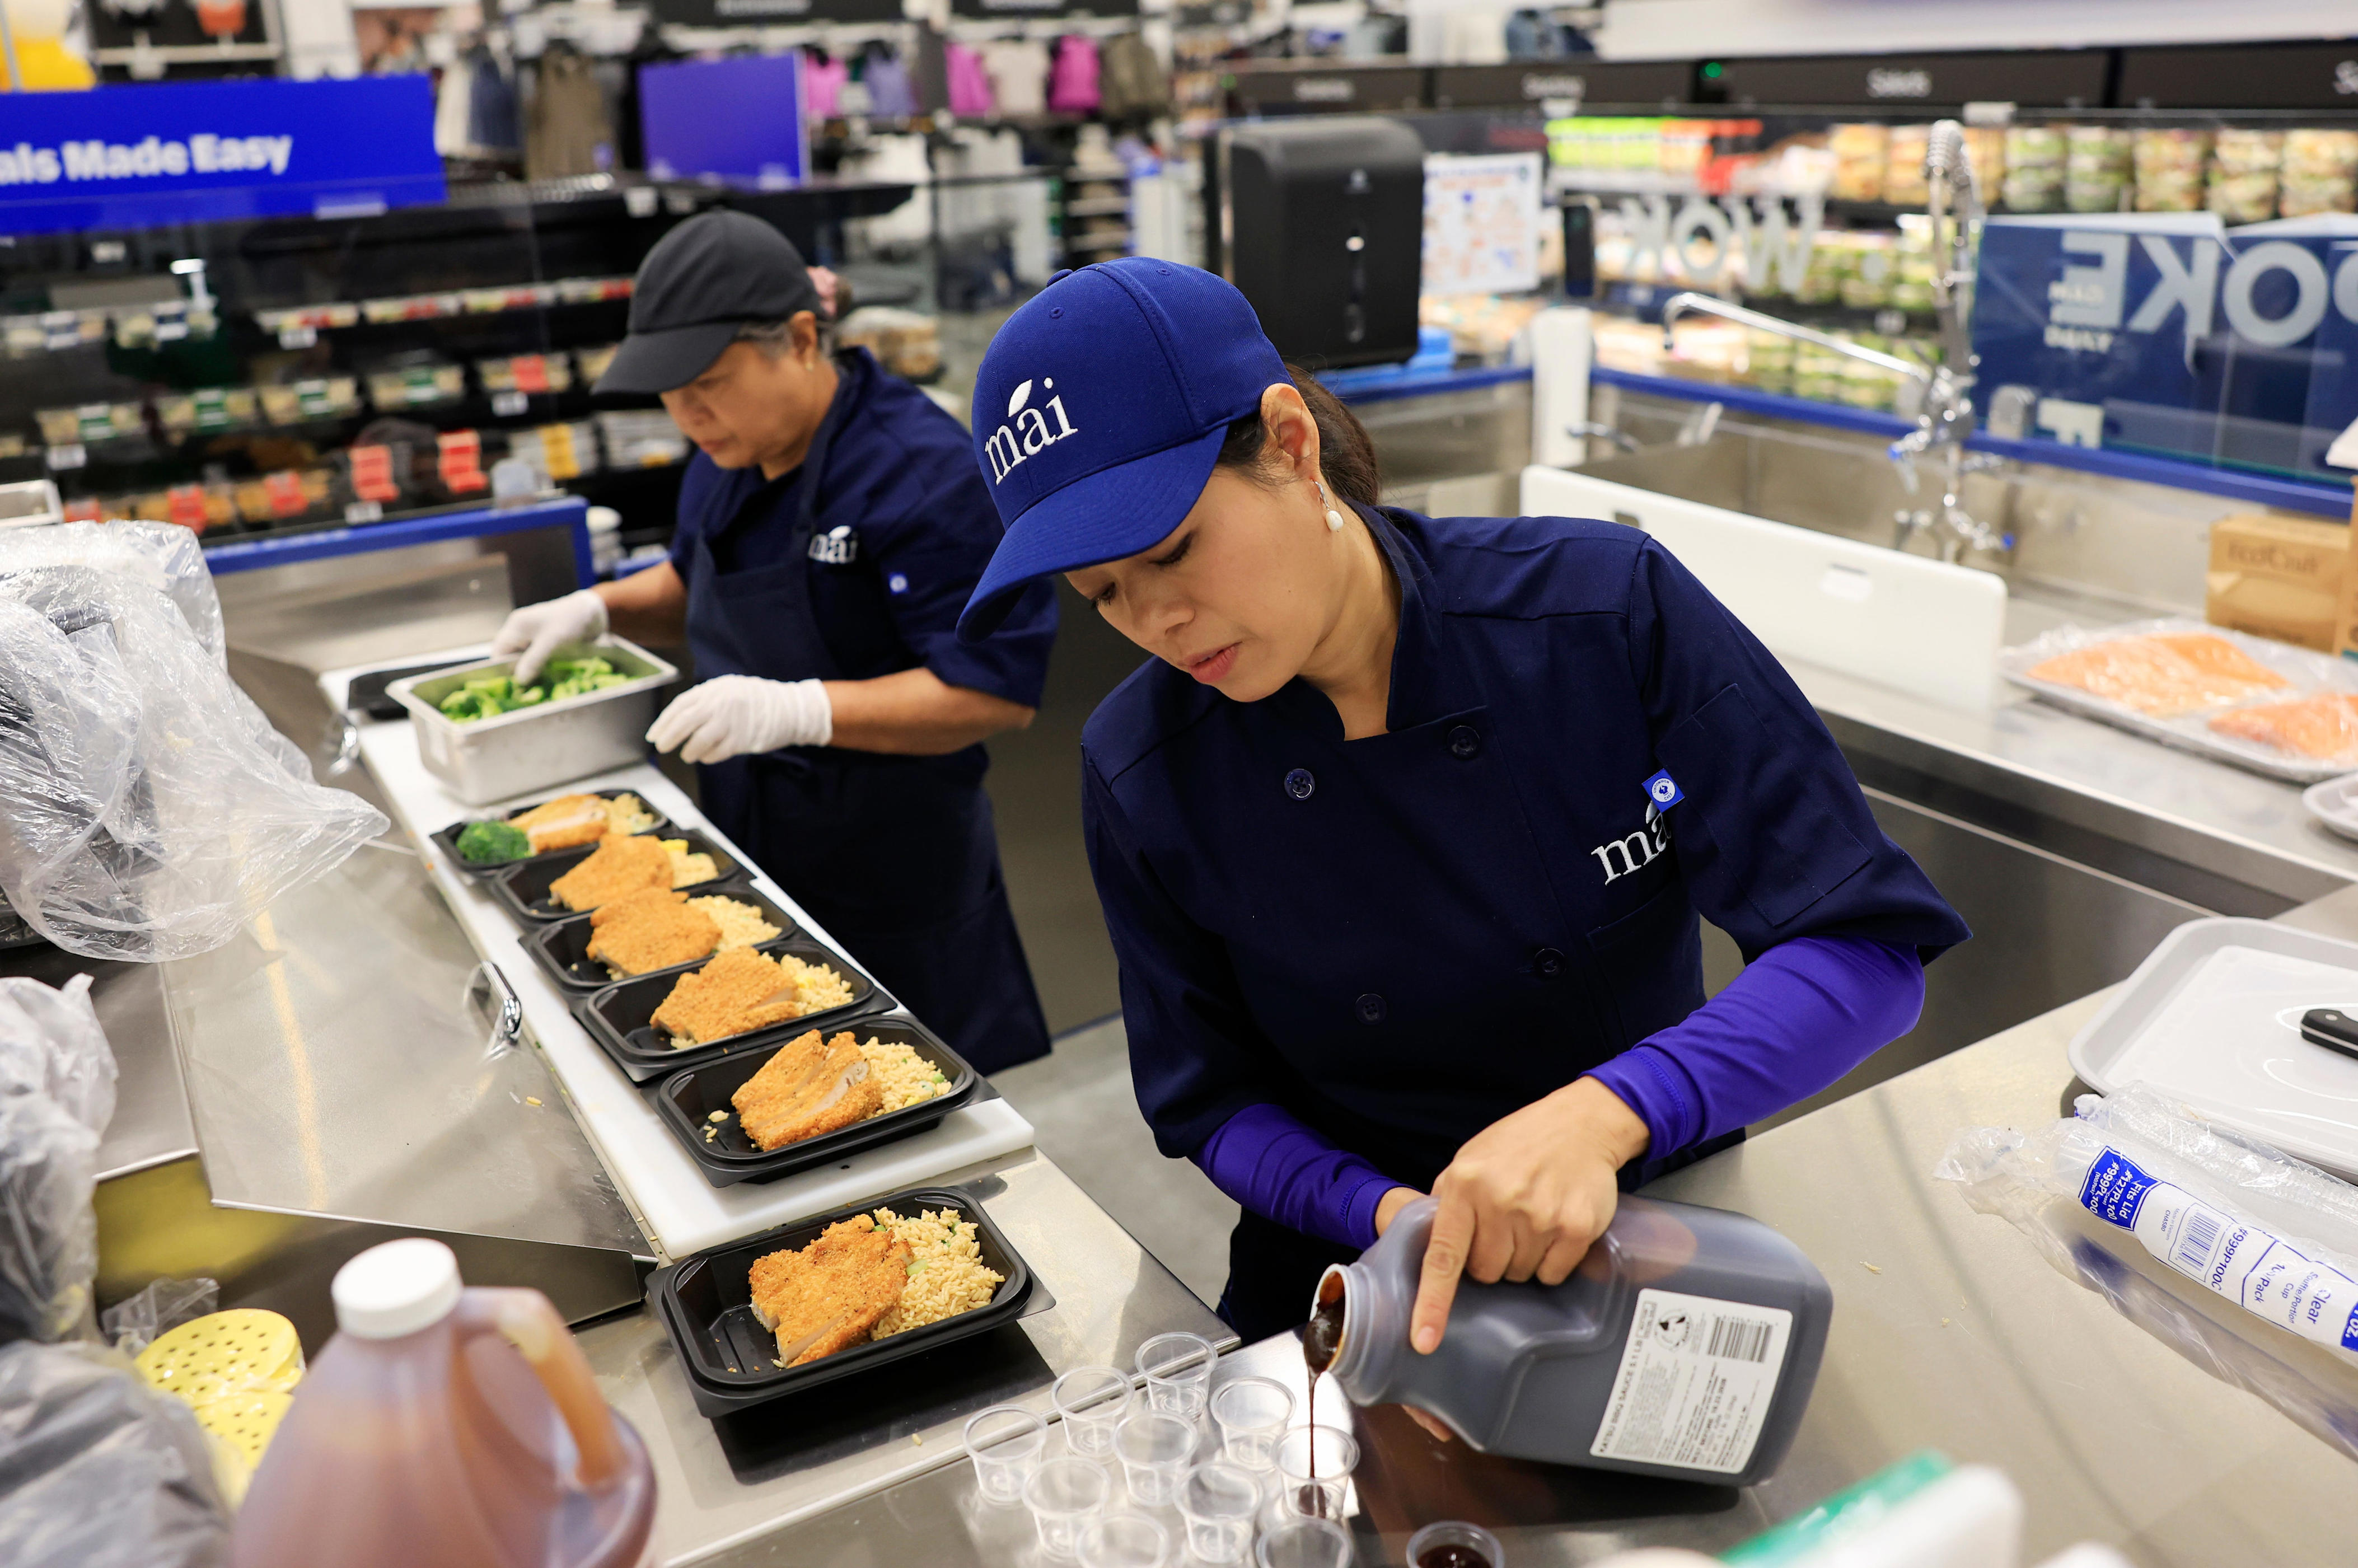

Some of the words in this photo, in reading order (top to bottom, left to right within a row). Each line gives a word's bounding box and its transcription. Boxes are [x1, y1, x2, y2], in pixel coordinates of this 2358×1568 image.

[62, 135, 189, 180] Made
[189, 133, 292, 175] Easy
[2126, 1181, 2143, 1201] Fits
[2119, 1202, 2134, 1219] Lid
[2161, 1210, 2170, 1232] CHA580
[2211, 1227, 2248, 1291] #999P100C
[2281, 1283, 2294, 1299] Cup
[2307, 1289, 2331, 1324] Clear
[1609, 1402, 1624, 1424] BBQ
[1617, 1369, 1635, 1401] SAUCE
